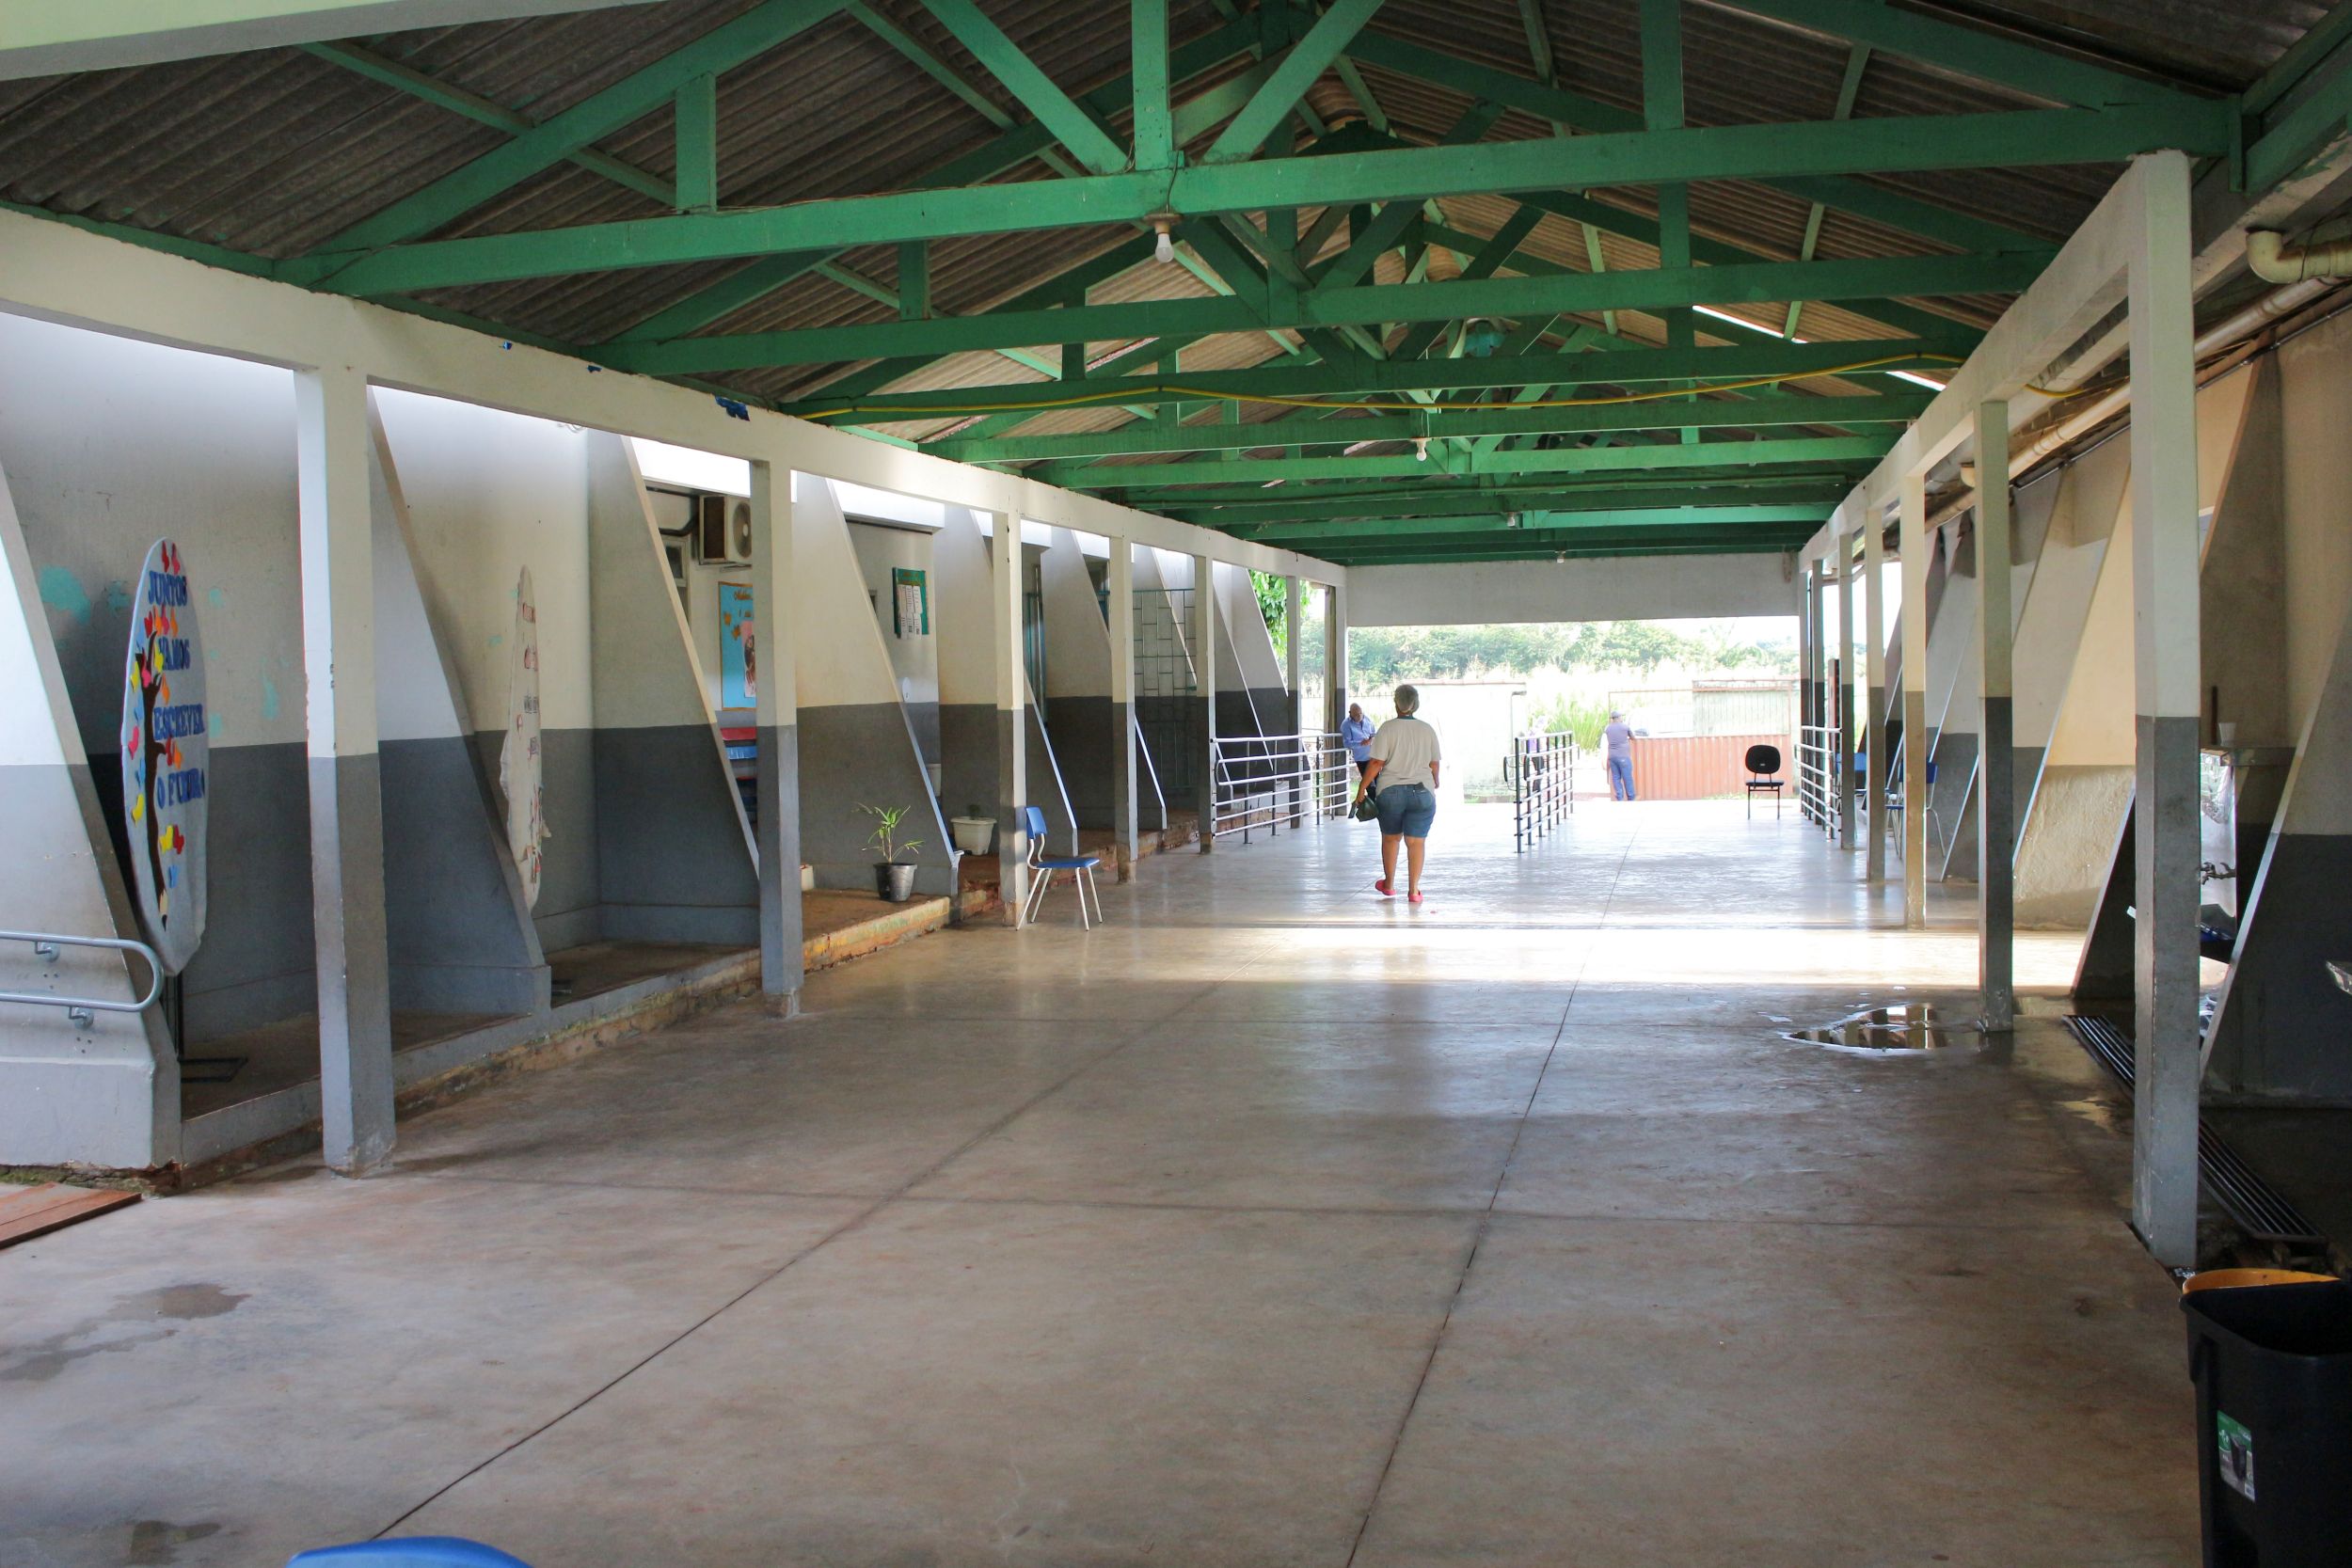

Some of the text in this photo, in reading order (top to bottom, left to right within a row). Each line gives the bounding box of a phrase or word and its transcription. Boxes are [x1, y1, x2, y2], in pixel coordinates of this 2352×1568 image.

[148, 570, 188, 607] JUNTOS
[158, 636, 191, 671] VAMOS
[153, 703, 205, 741] ESCREVER
[157, 776, 167, 810] O
